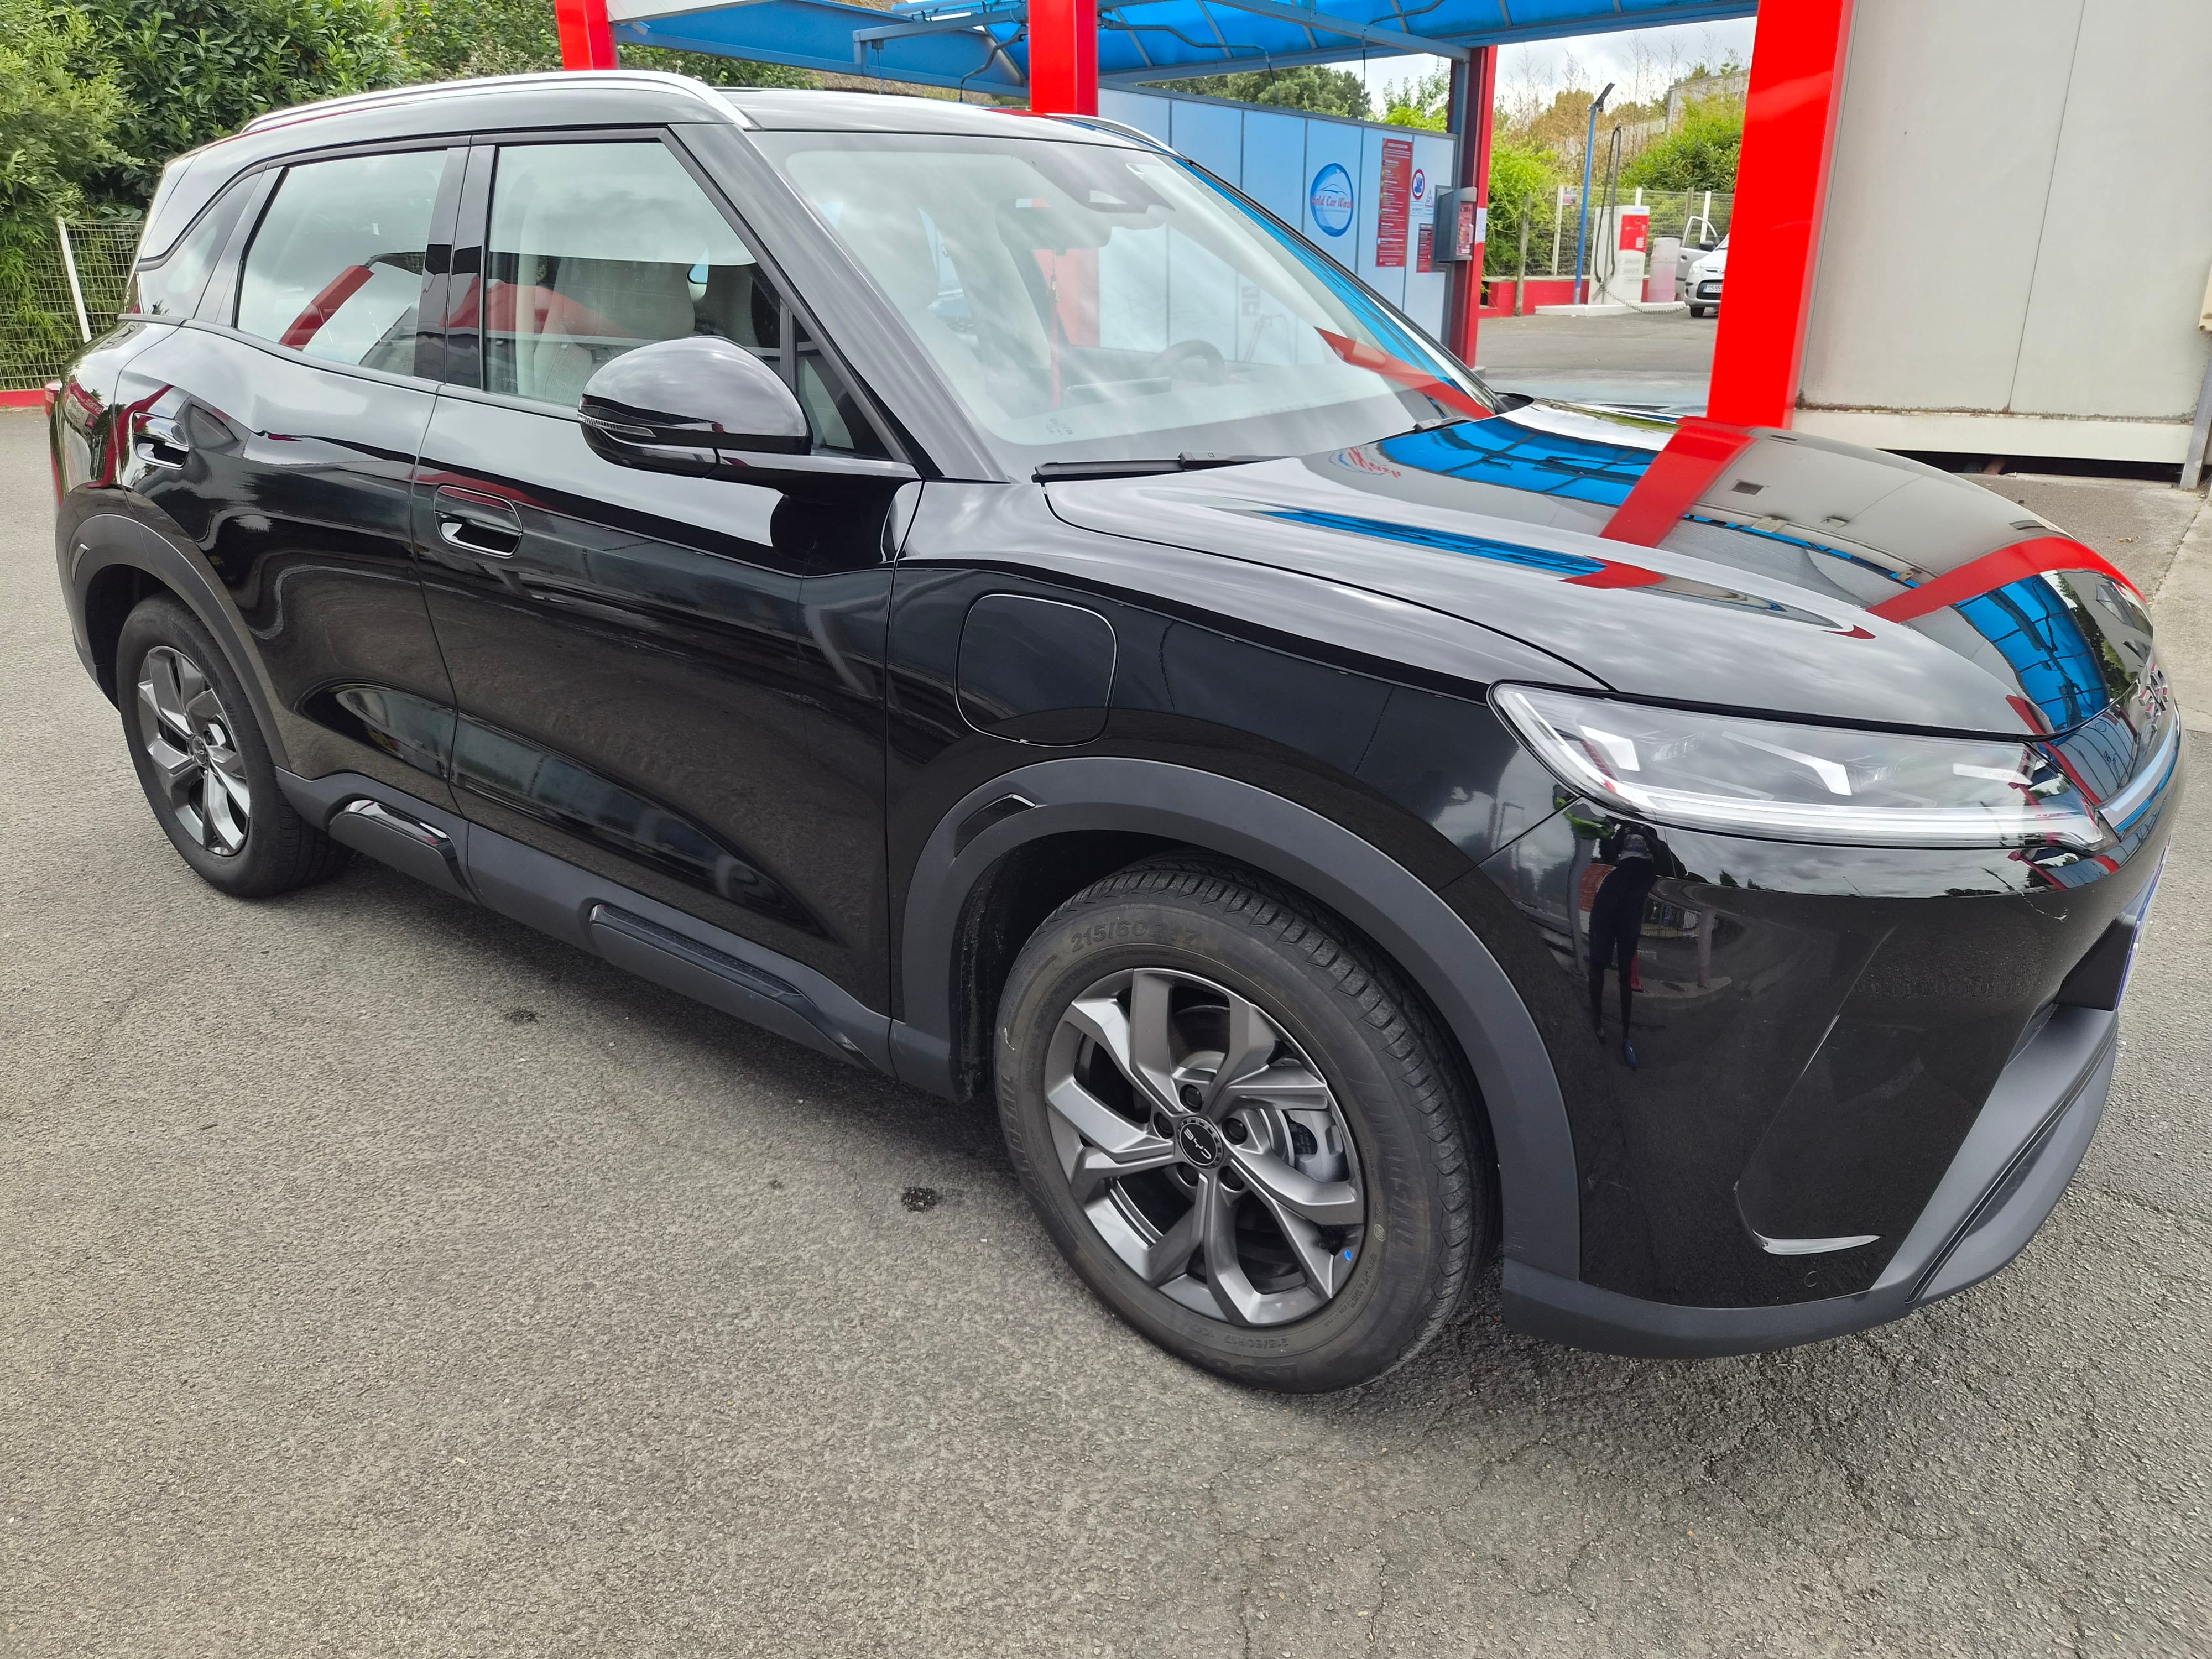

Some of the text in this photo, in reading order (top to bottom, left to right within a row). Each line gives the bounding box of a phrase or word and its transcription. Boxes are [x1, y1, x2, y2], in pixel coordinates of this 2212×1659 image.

[1327, 196, 1337, 207] Car
[1338, 197, 1353, 209] Wash
[1183, 1128, 1212, 1160] BYD
